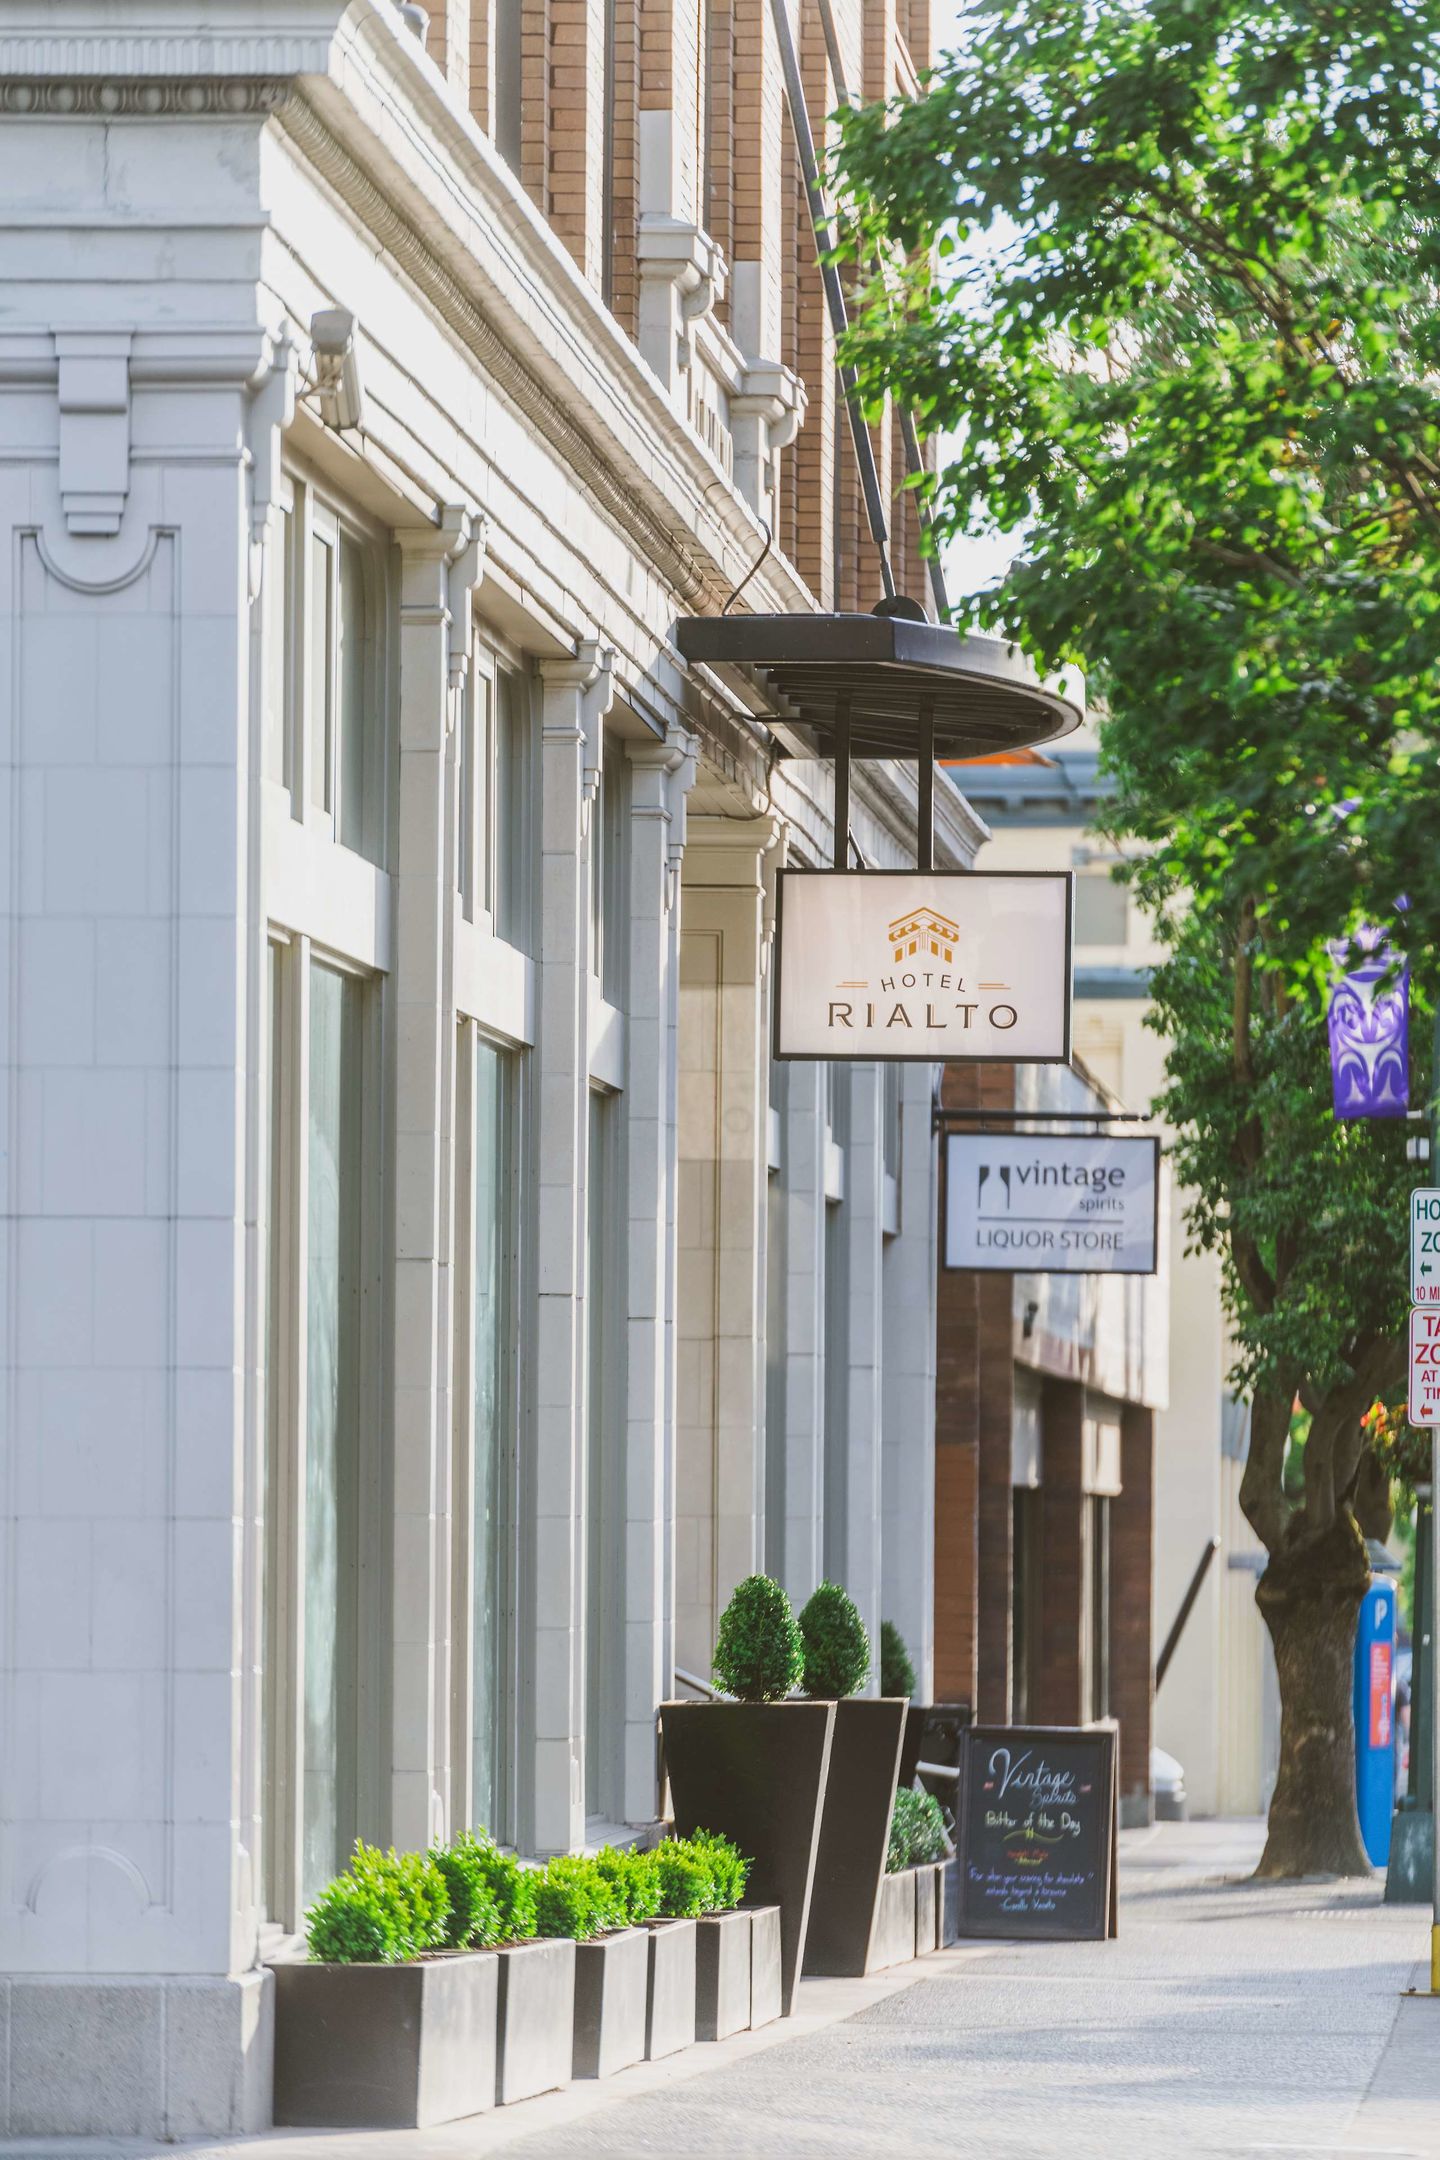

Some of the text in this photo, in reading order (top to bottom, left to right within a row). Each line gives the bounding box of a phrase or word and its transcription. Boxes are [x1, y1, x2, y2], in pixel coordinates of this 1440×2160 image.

[881, 973, 966, 993] HOTEL
[828, 1002, 1018, 1029] RIALTO
[1016, 1160, 1125, 1193] vintage
[1079, 1198, 1124, 1212] spirits
[976, 1229, 1124, 1250] LIQUOR STORE
[1416, 1286, 1426, 1300] 10
[1421, 1370, 1438, 1382] AT
[989, 1748, 1075, 1799] Vintage
[1023, 1812, 1034, 1827] of
[1039, 1812, 1055, 1827] the
[1061, 1812, 1081, 1836] Day
